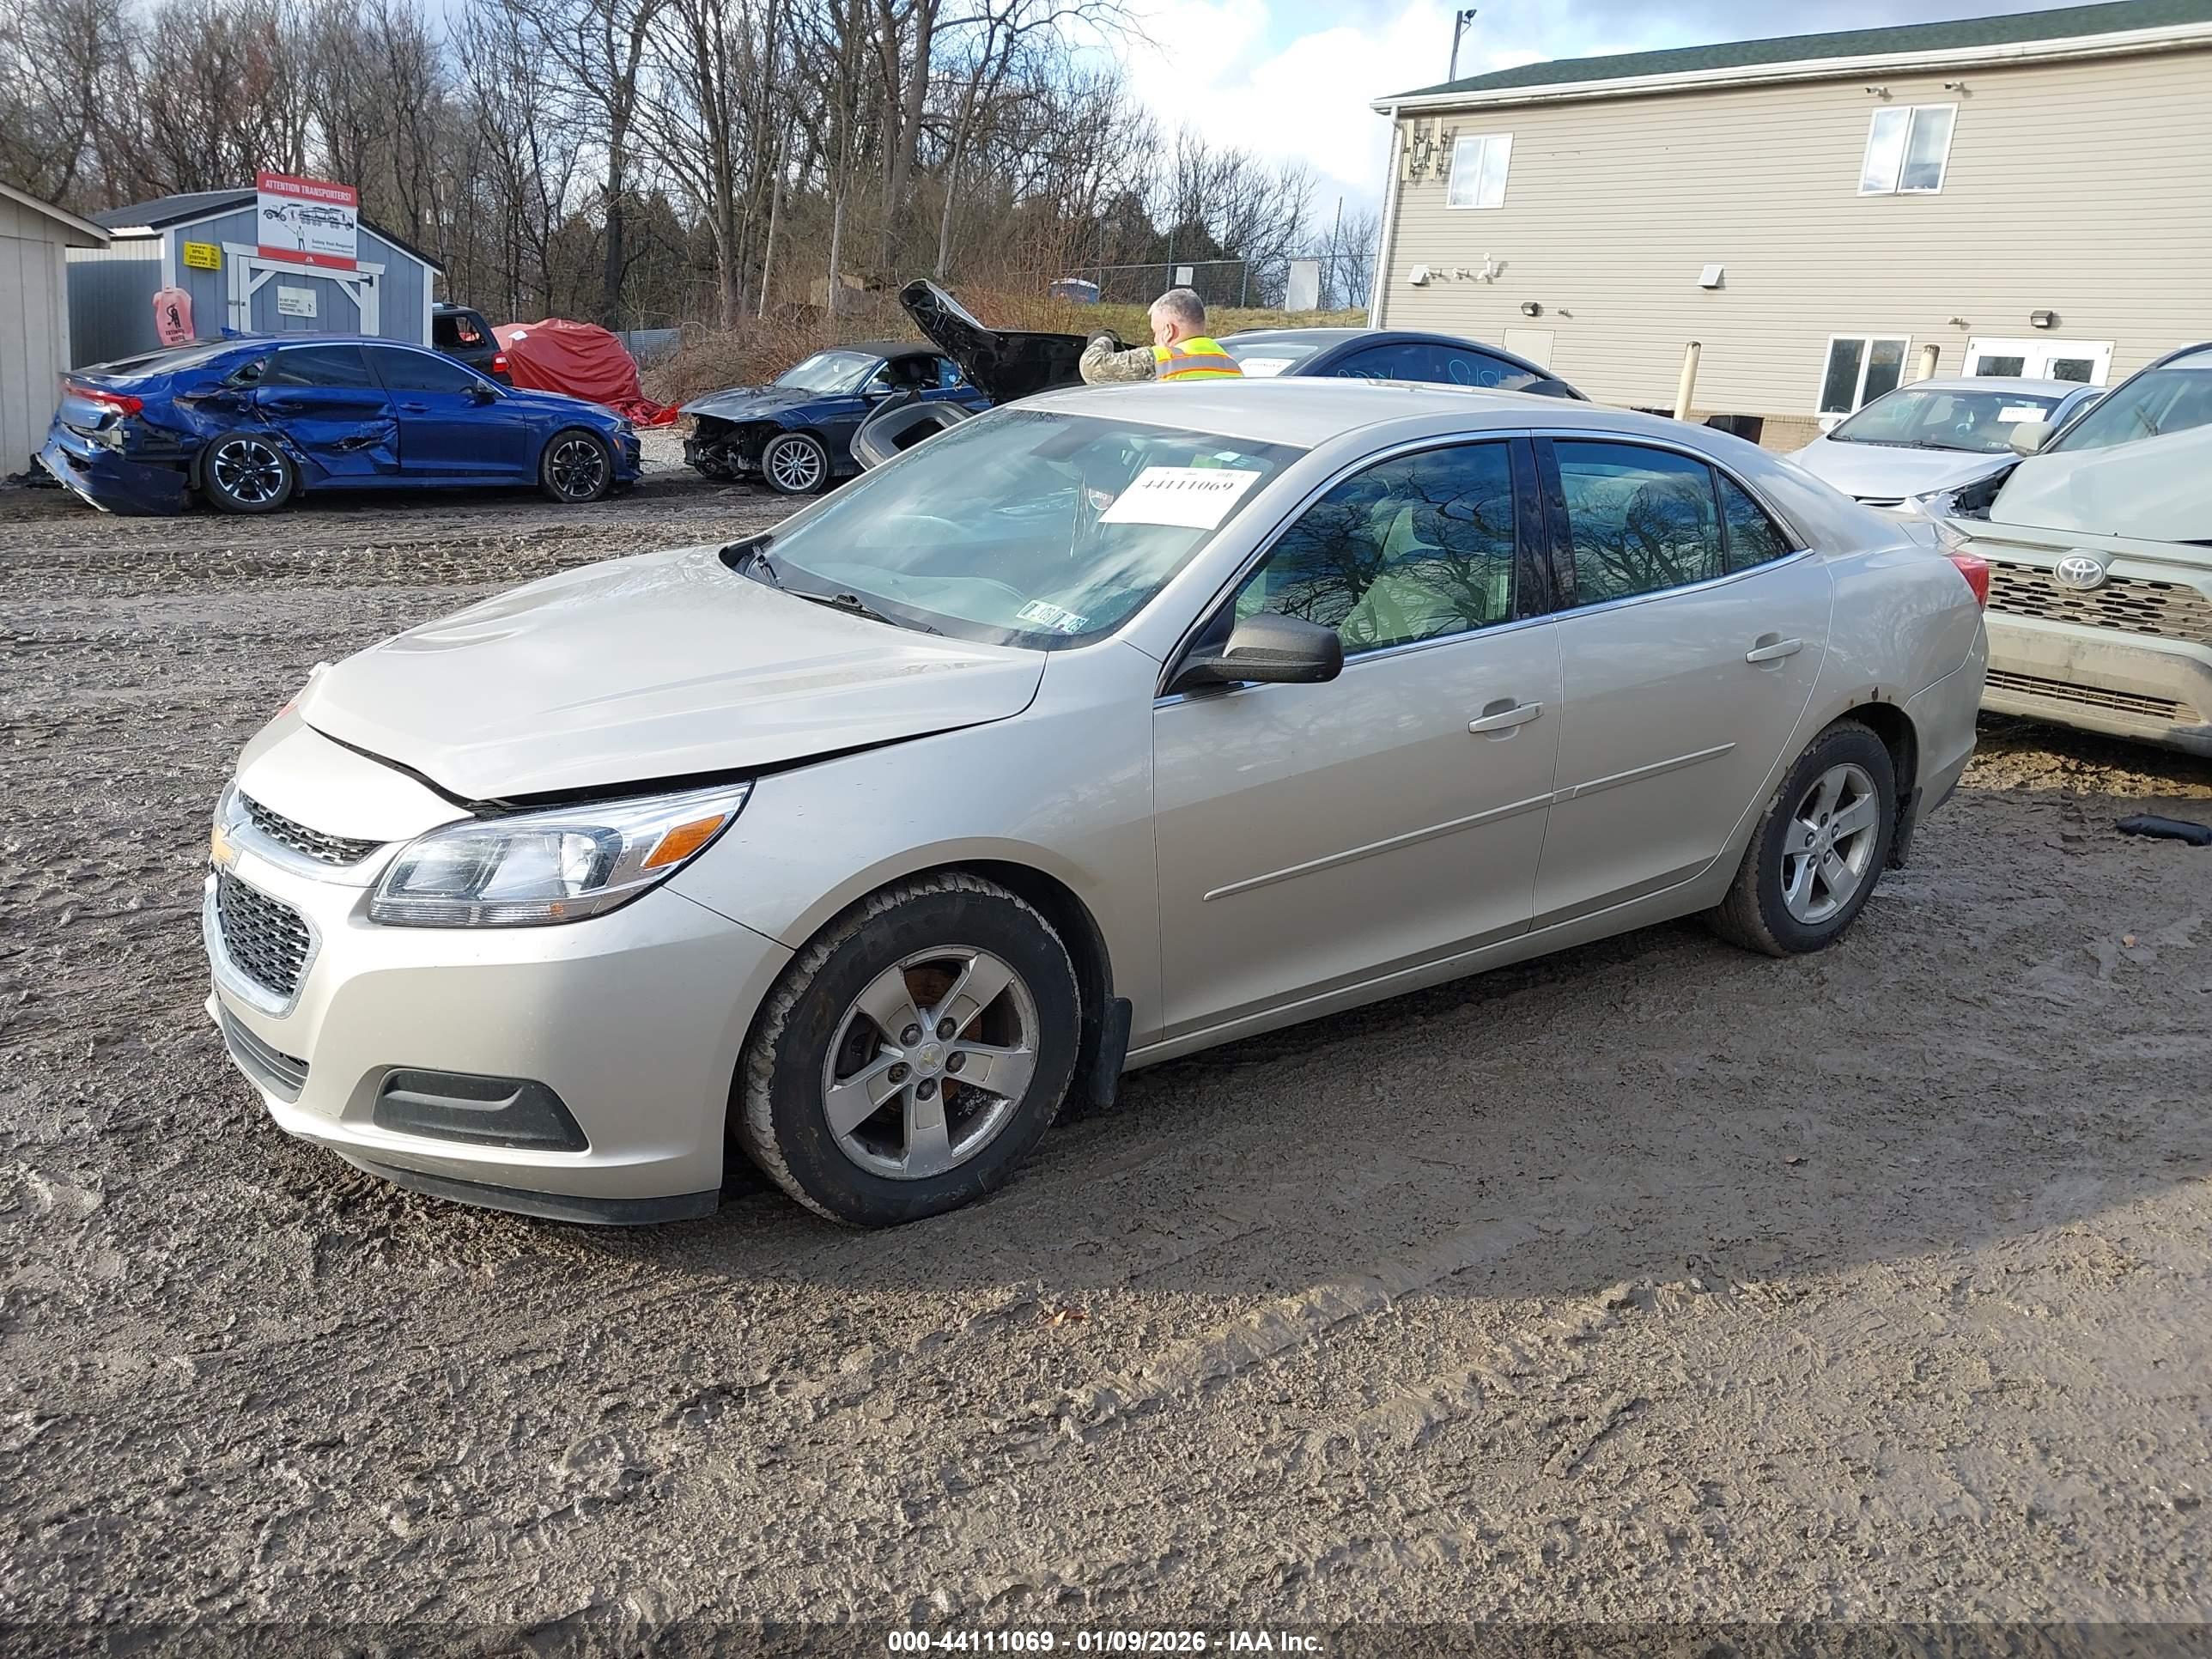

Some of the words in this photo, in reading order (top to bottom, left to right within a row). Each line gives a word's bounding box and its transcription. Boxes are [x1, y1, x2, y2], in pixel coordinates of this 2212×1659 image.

[265, 179, 301, 193] ATTENTION
[301, 185, 351, 202] TRANSPORTERS!
[1141, 479, 1235, 491] 44111069
